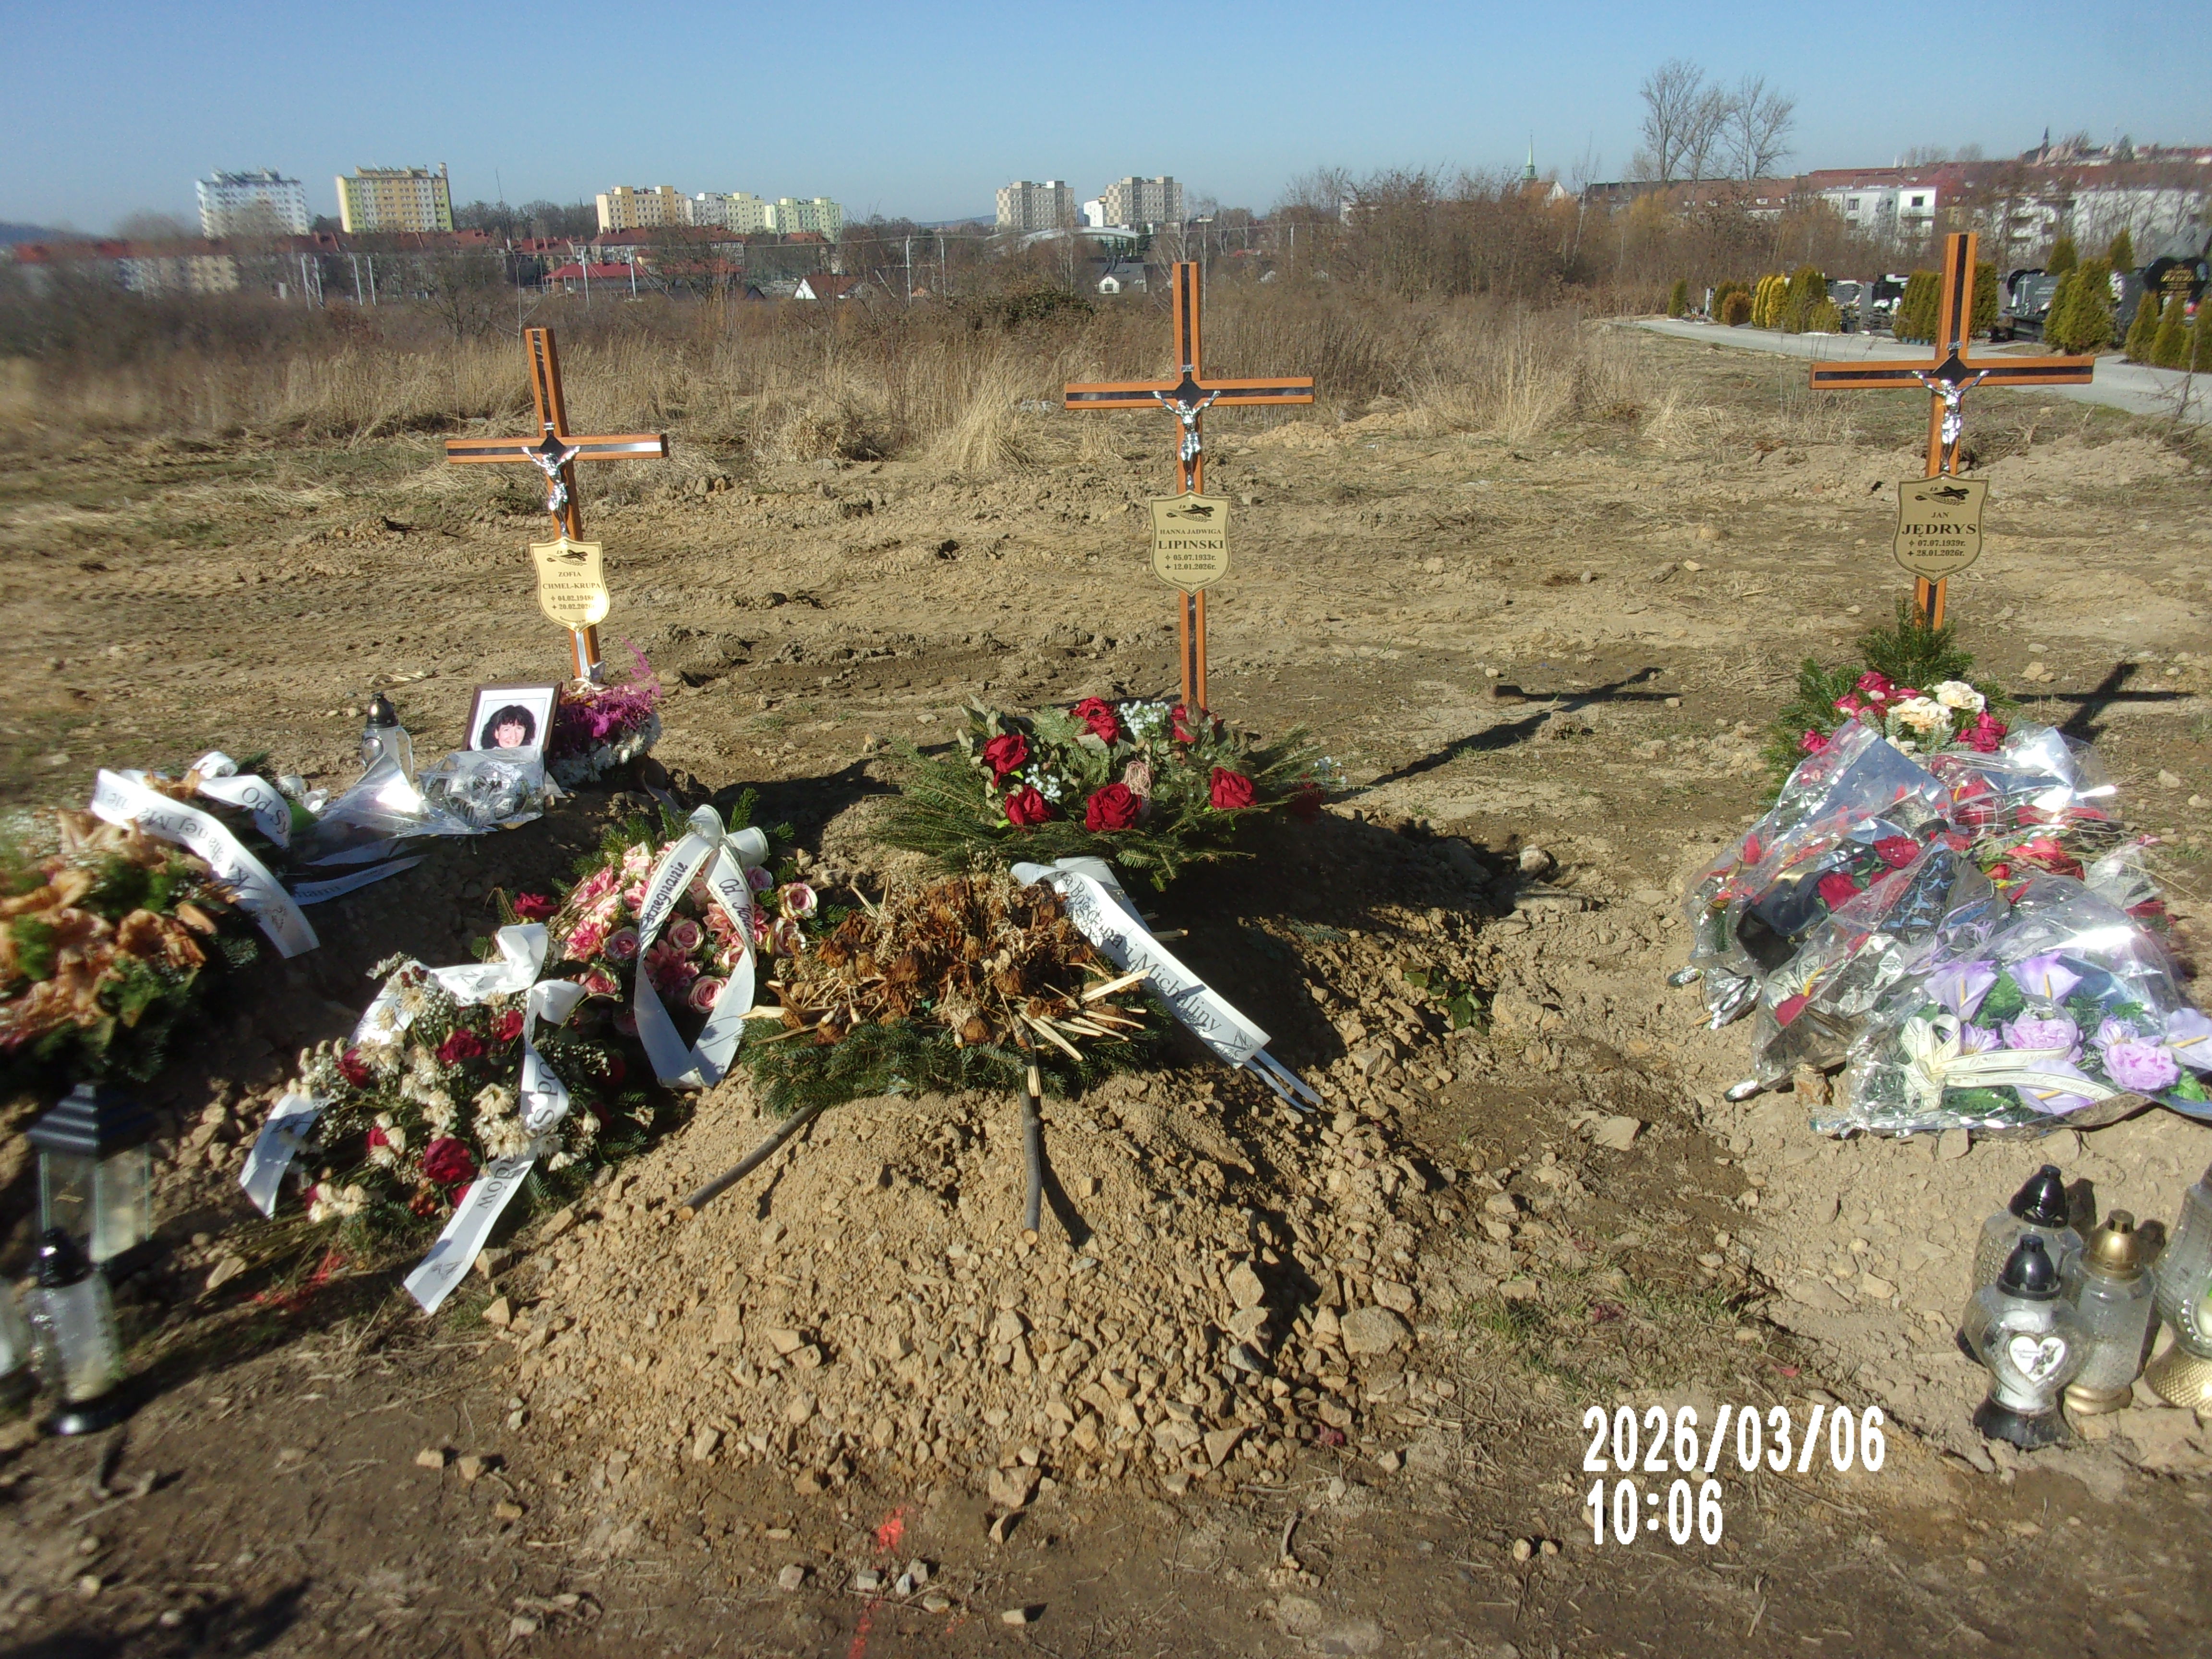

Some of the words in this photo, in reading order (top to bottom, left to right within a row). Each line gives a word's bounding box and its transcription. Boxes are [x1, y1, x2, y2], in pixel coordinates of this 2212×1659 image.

[1902, 524, 1976, 538] JĘDRYS
[1158, 540, 1224, 550] LIPINSKI
[242, 787, 273, 813] Od
[719, 878, 745, 896] Od
[1129, 951, 1222, 1033] Michaliny
[537, 1062, 558, 1097] Od
